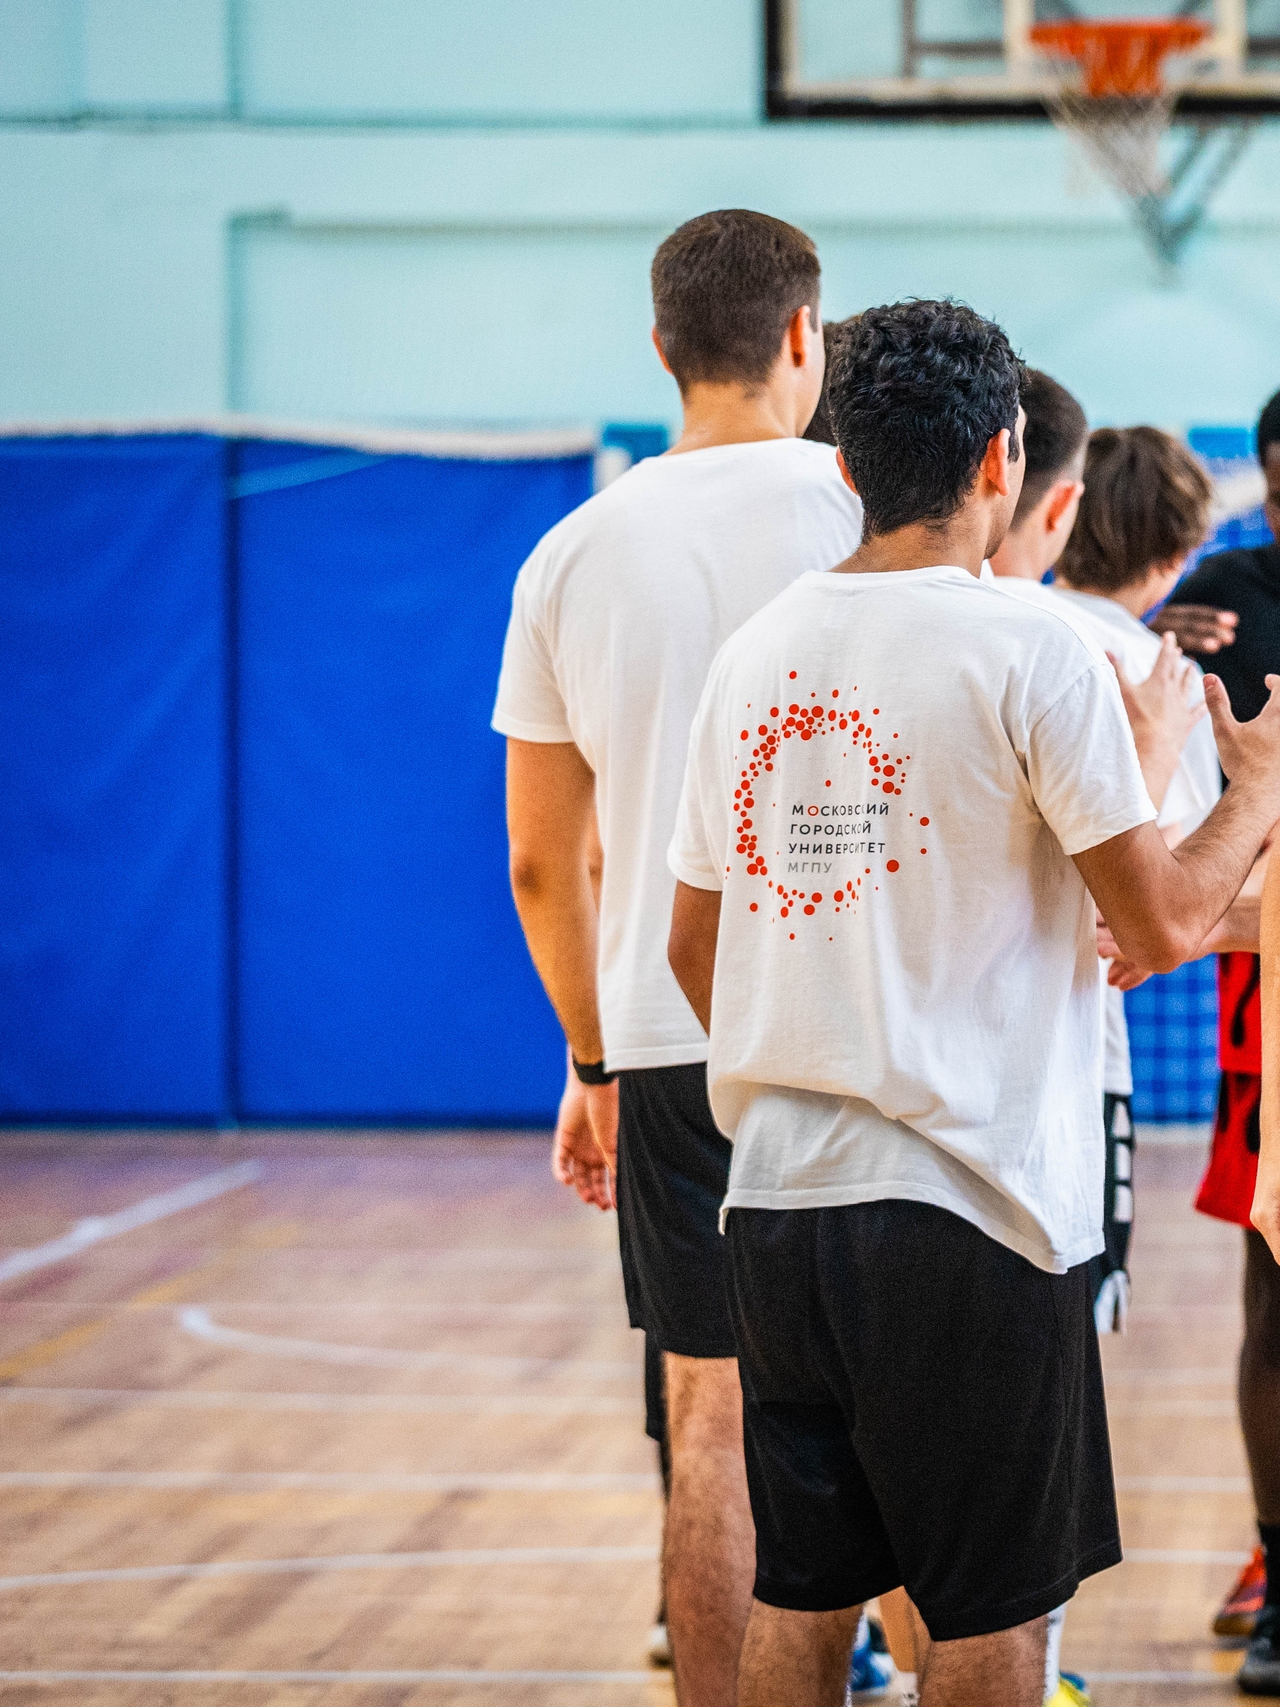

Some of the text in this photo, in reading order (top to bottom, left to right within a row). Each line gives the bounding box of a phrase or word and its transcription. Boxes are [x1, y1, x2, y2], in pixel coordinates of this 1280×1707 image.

[790, 820, 871, 836] ГОРОДСКОЙ
[788, 842, 886, 854] УНИВЕРСИТЕТ
[787, 862, 832, 873] МГПУ
